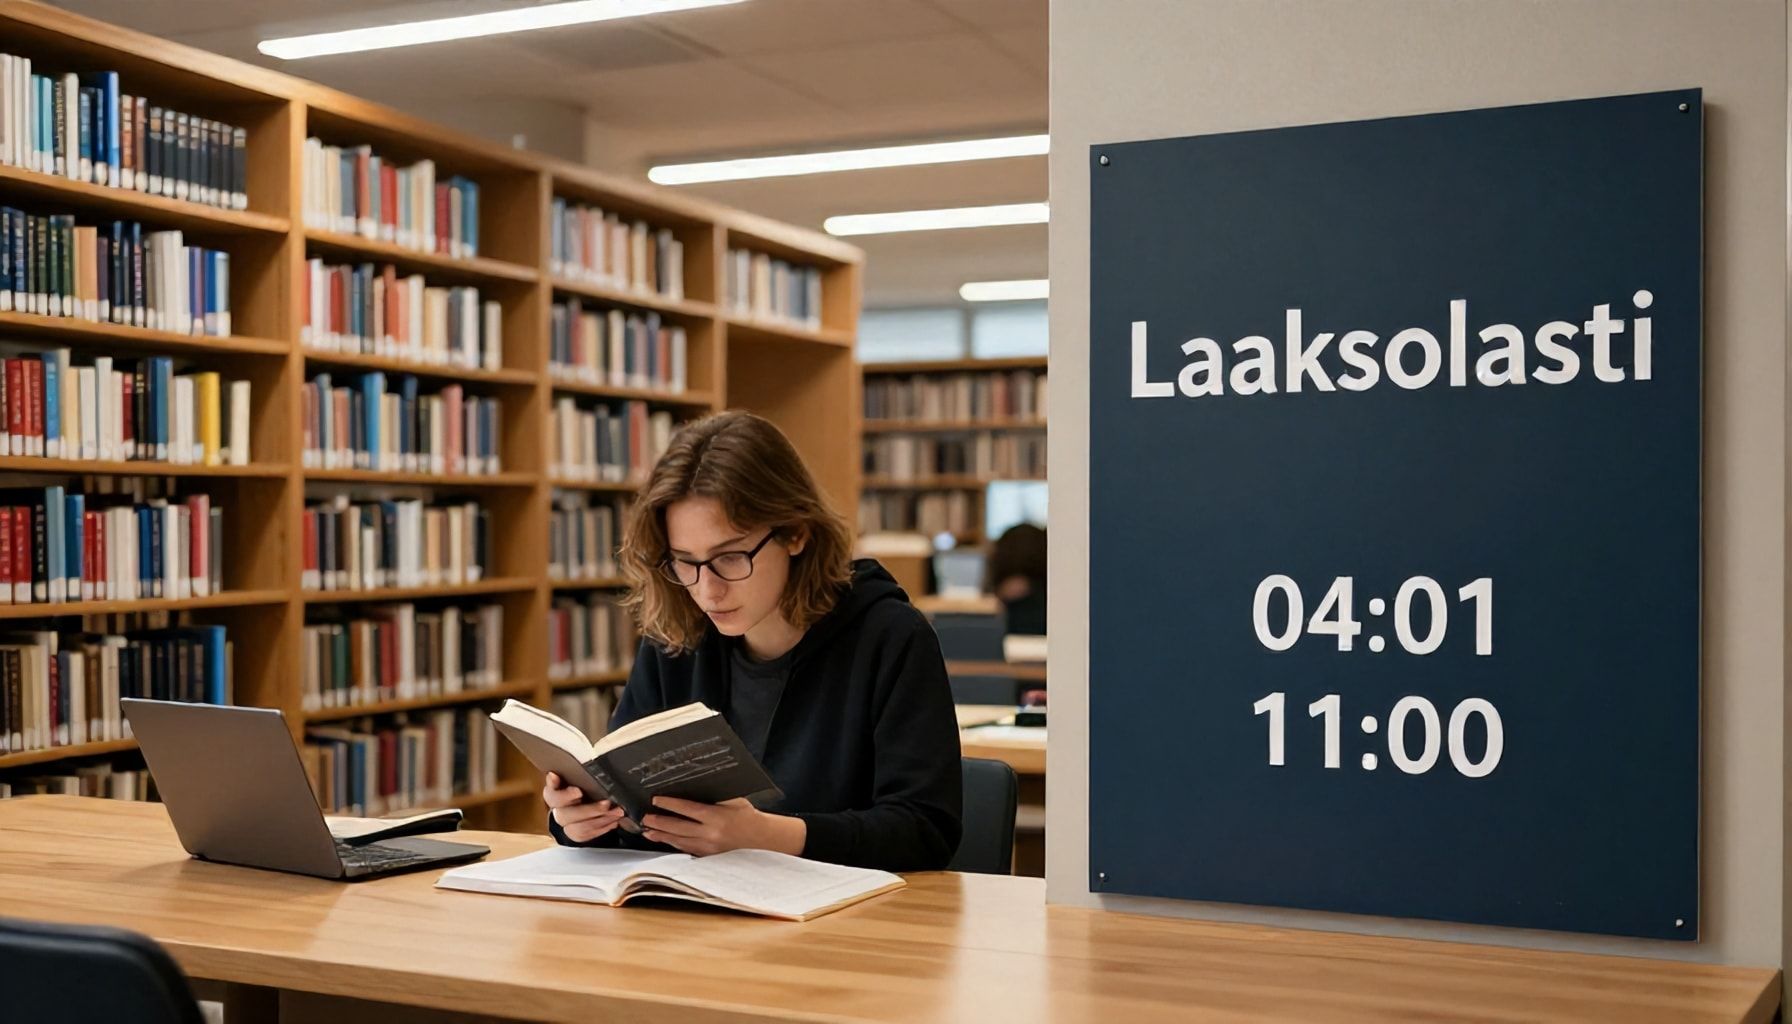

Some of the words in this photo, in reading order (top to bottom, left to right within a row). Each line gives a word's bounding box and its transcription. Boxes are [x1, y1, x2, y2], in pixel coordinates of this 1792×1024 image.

[1131, 290, 1654, 398] Laaksolasti
[1253, 574, 1493, 656] 04:01
[1253, 692, 1504, 778] 11:00
